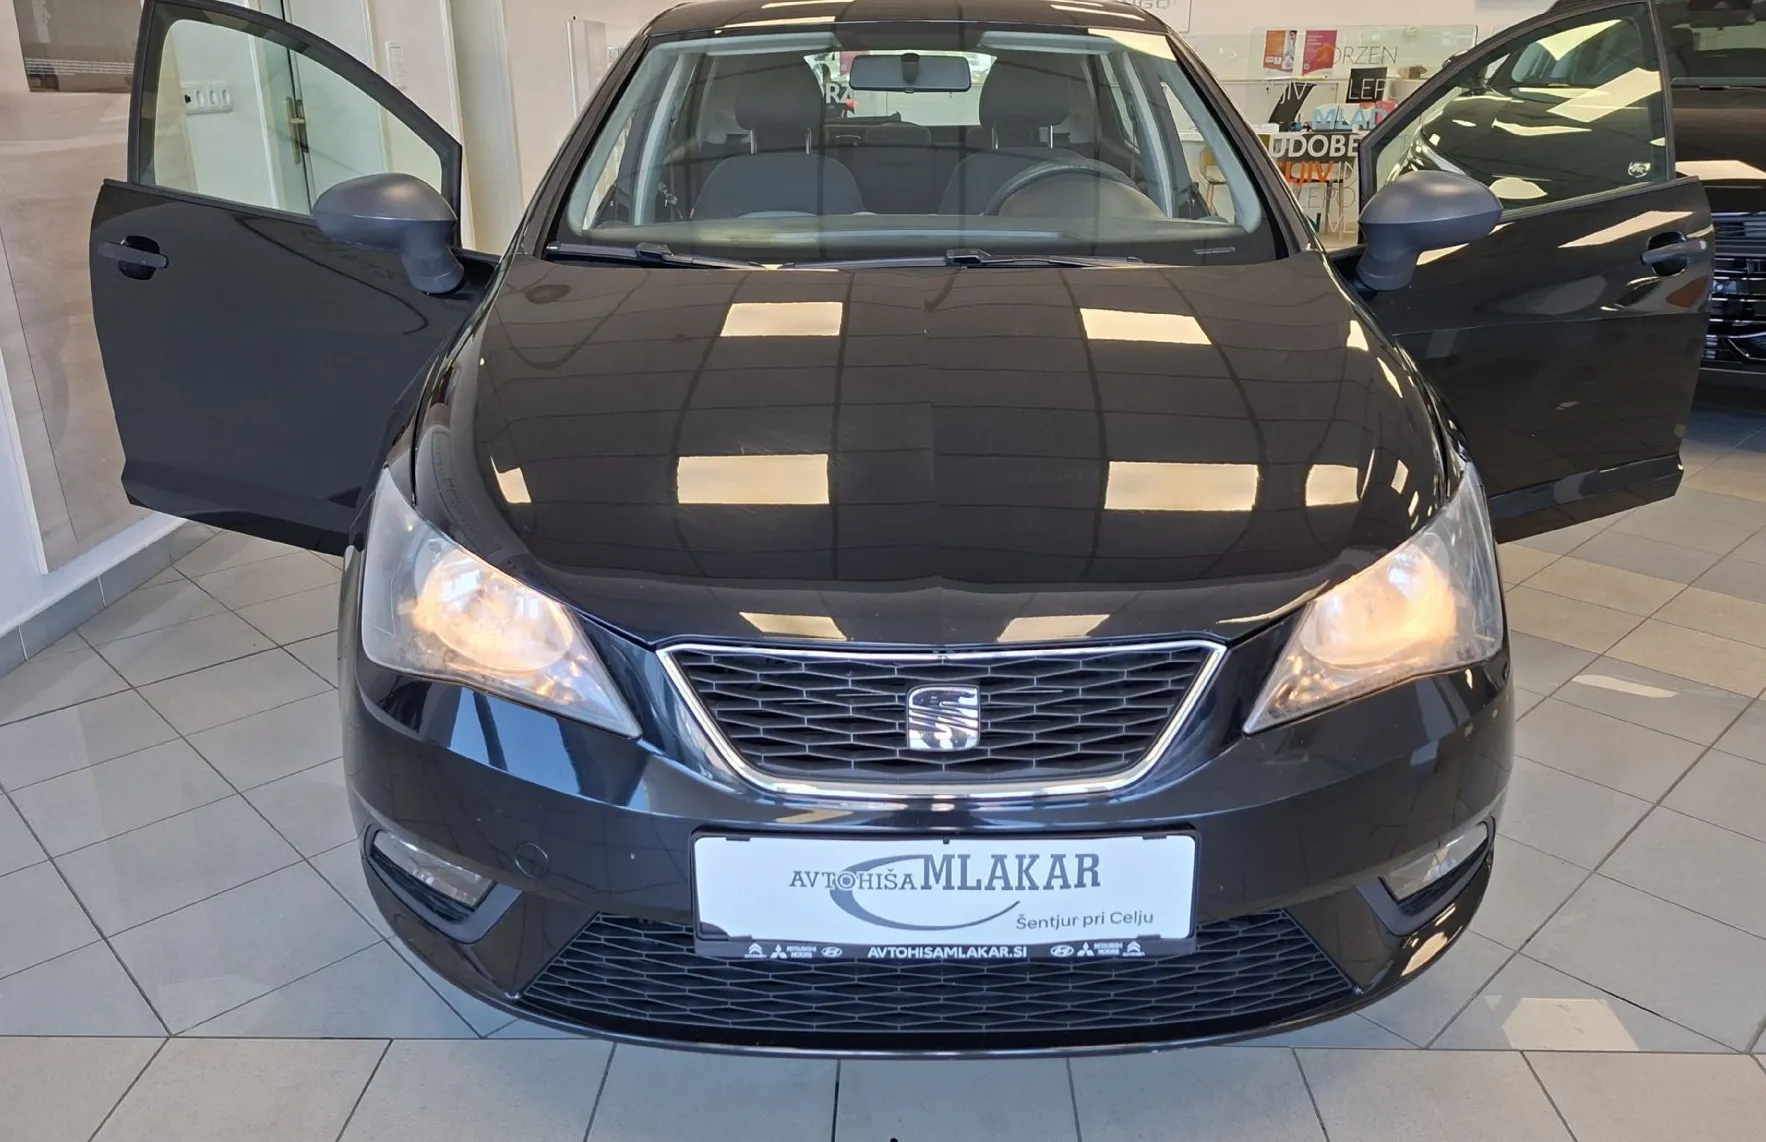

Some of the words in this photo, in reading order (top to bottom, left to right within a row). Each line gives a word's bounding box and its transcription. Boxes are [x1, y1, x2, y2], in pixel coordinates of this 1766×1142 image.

[788, 868, 918, 891] AVTOHIŠA
[921, 853, 1101, 891] MLAKAR
[1016, 913, 1078, 930] Šentjur
[1082, 911, 1105, 928] pri
[1110, 910, 1154, 926] Celju
[868, 945, 1027, 959] AVTOHISAMLAKAR.SI
